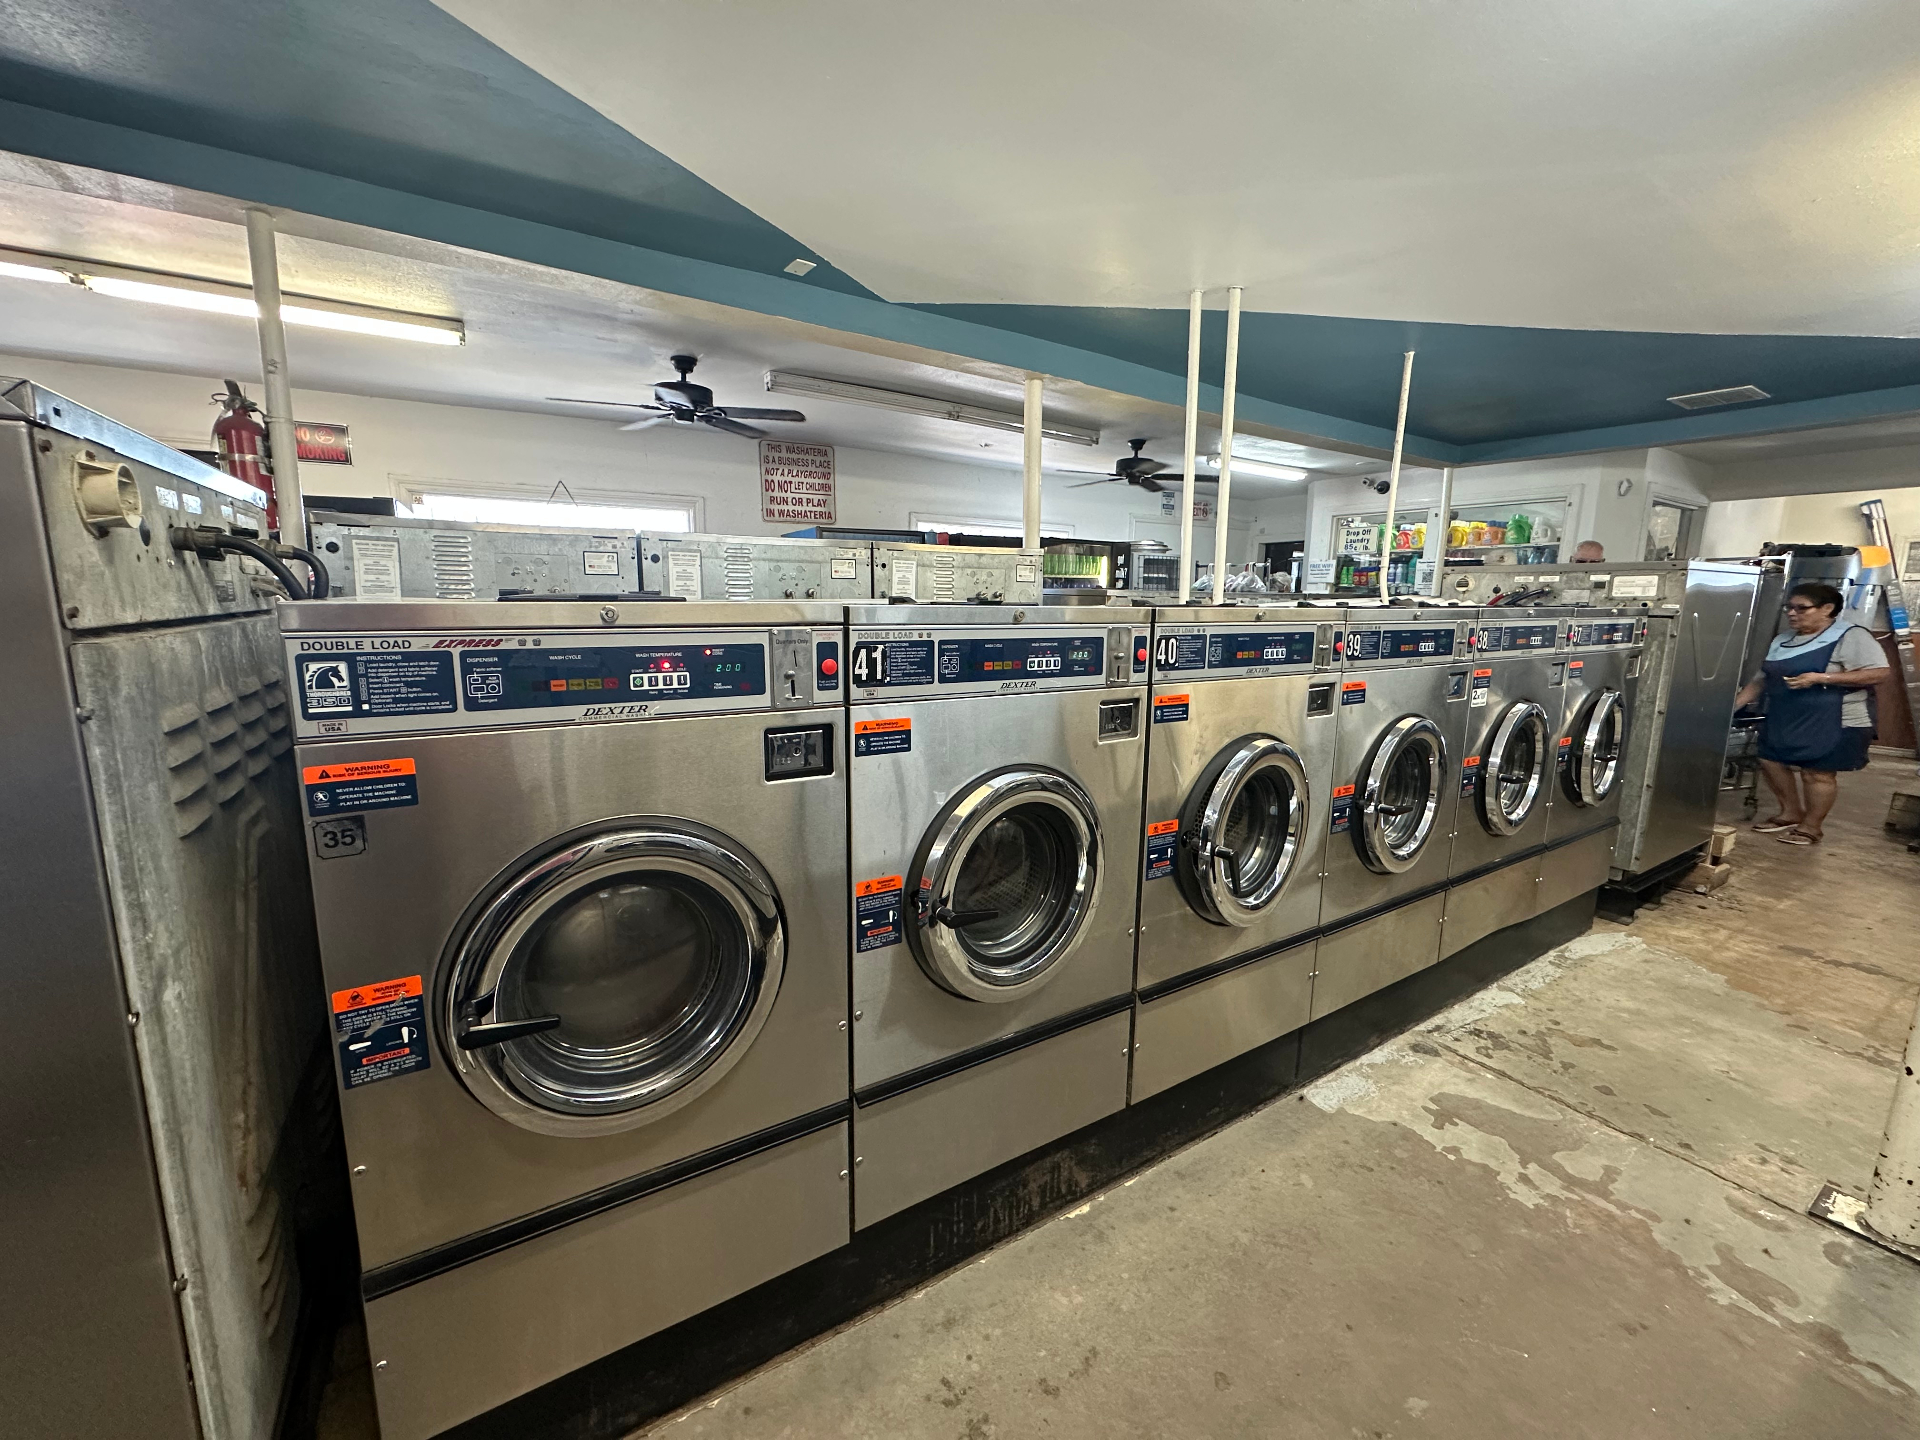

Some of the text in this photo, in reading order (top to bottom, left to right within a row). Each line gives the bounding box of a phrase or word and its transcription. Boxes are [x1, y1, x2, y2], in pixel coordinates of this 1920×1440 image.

[298, 444, 345, 460] MOKING
[766, 444, 828, 457] THIS WASHATERIA
[764, 455, 831, 469] IS A BUSINESS PLACE
[765, 467, 831, 480] NOT A PLAYGROUND
[765, 479, 831, 493] DO NOT LET CHILDREN
[770, 496, 827, 508] RUN OR PLAY
[766, 508, 832, 520] IN WASHATERIA
[300, 639, 503, 651] DOUBLE LOAD EXPRESS
[1157, 638, 1176, 664] 40
[854, 645, 883, 680] 41
[307, 697, 352, 707] 350
[582, 705, 648, 716] DEXTER
[345, 764, 390, 772] WARNING
[323, 828, 356, 848] 35
[373, 983, 406, 993] WARNING
[366, 1050, 406, 1062] IMPORTANT
